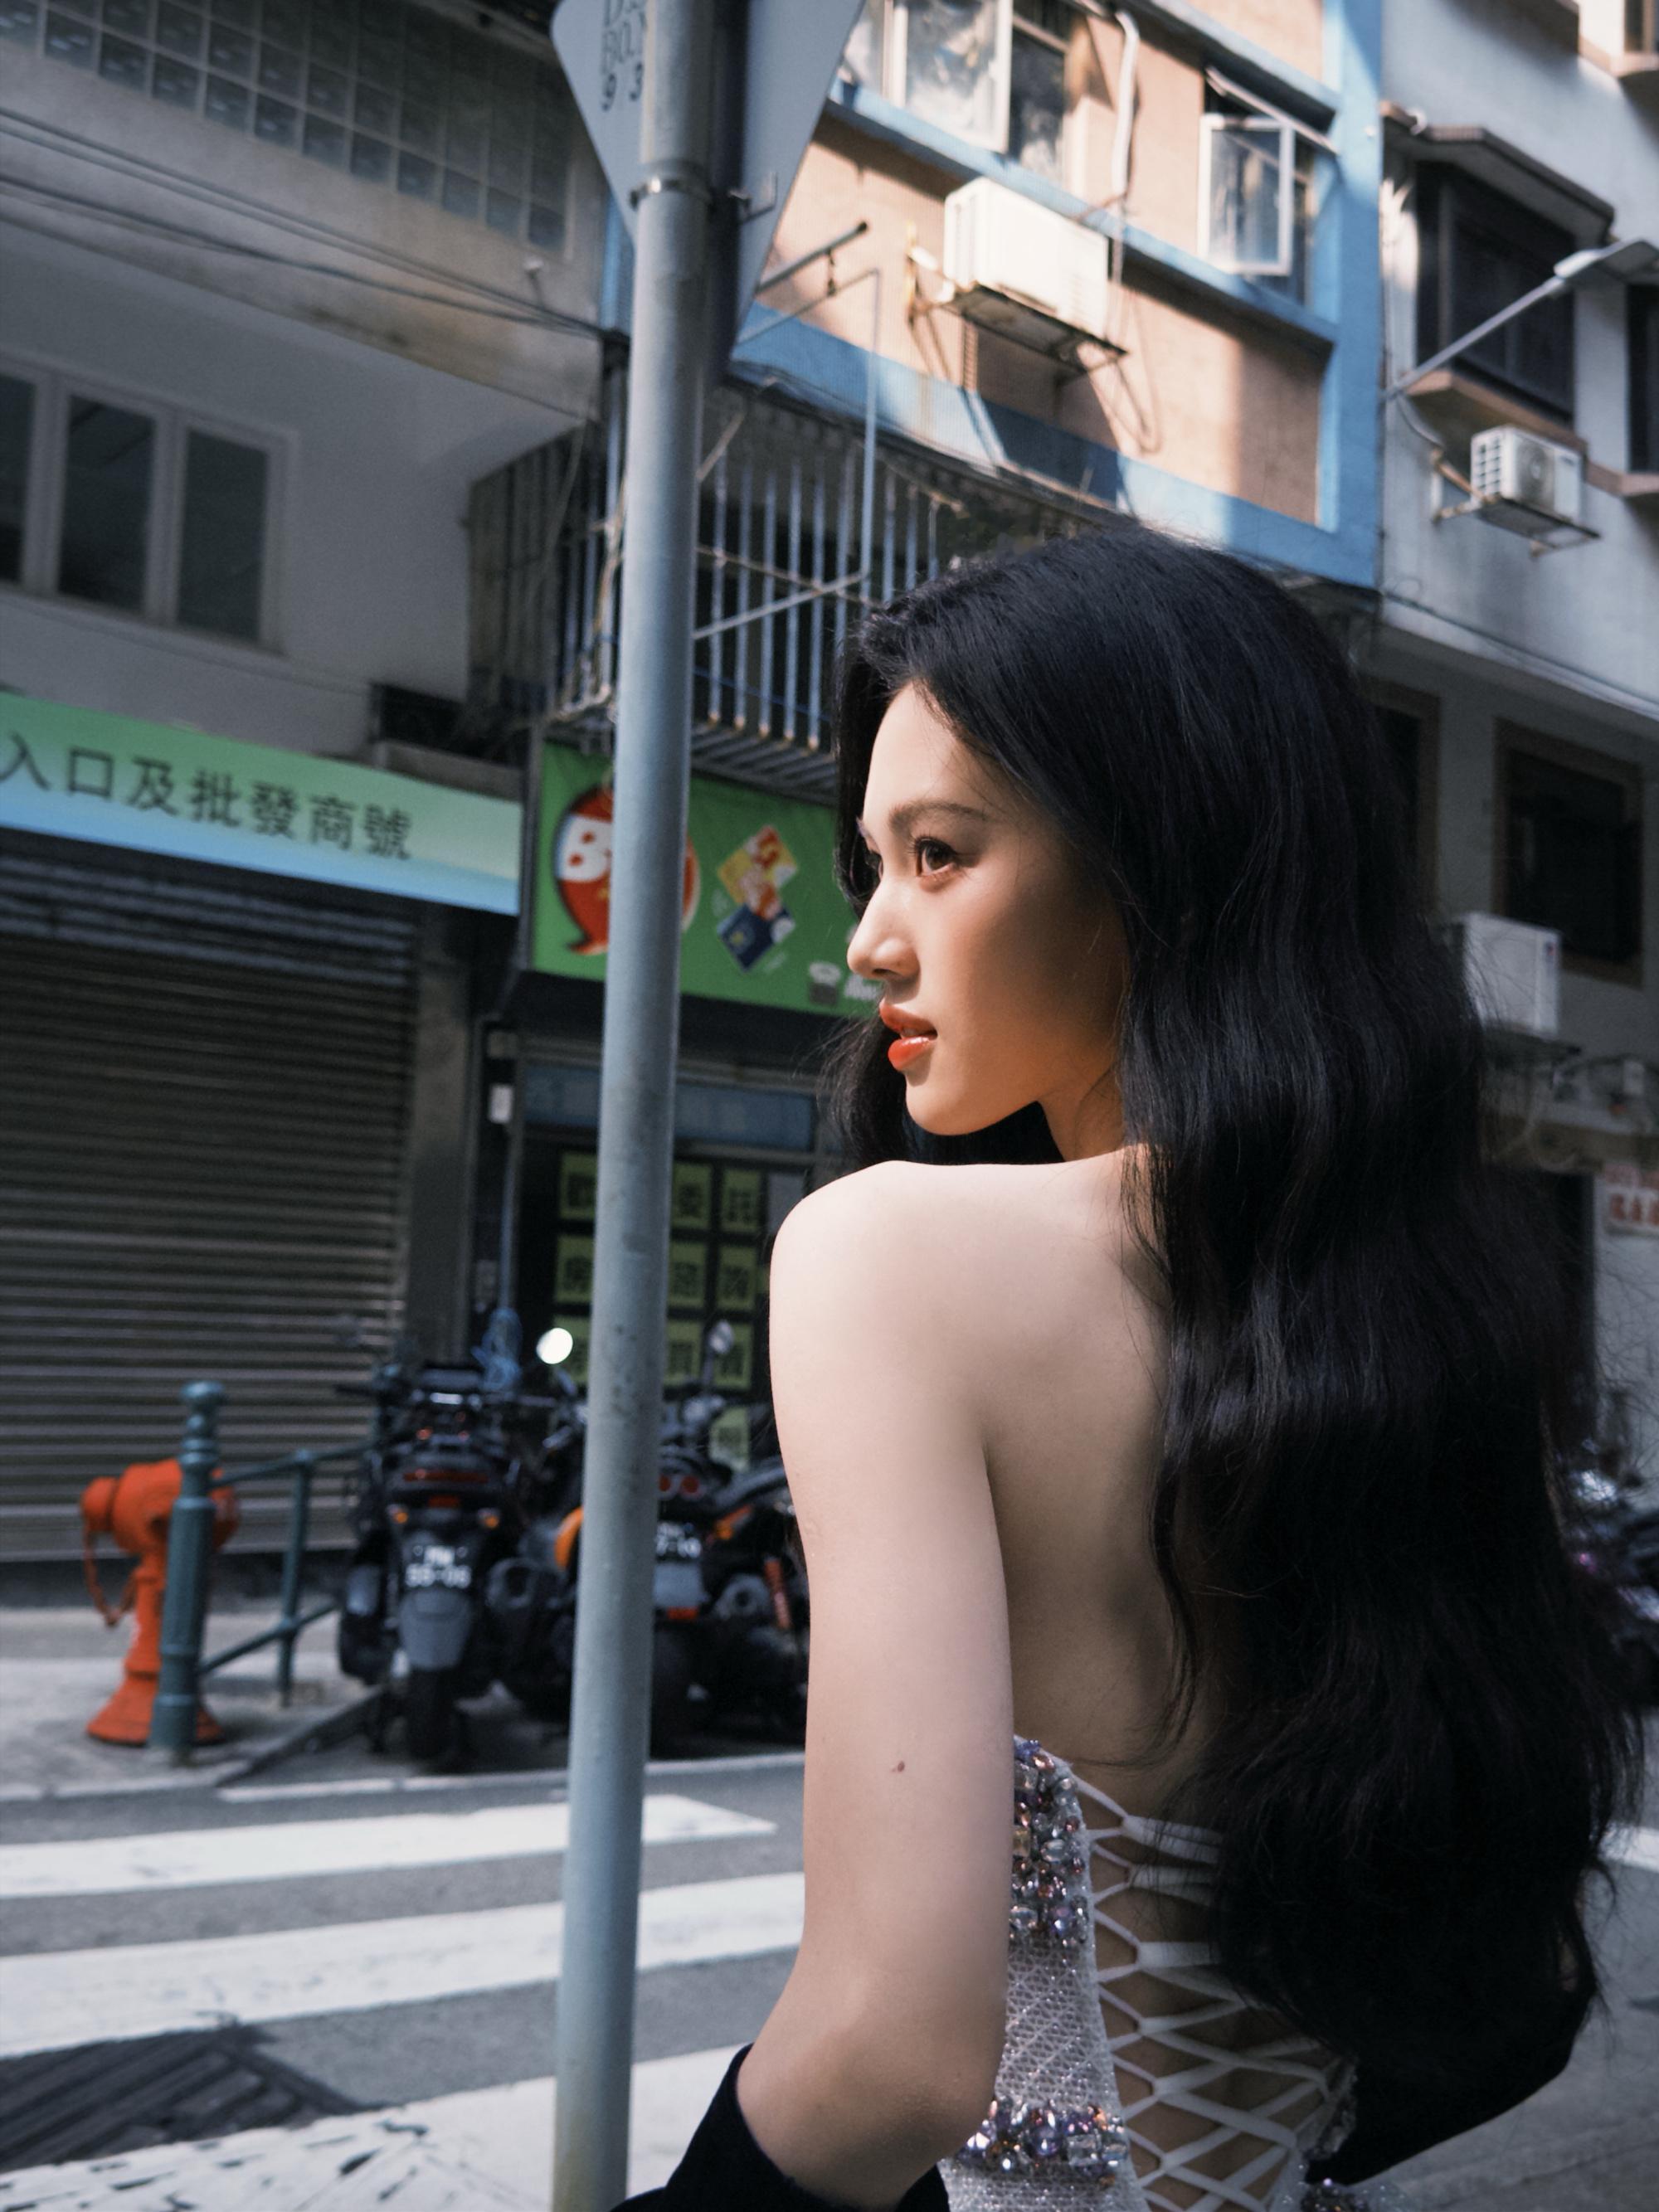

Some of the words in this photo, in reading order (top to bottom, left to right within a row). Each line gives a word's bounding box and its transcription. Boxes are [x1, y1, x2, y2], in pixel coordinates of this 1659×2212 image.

[0, 729, 411, 860] 入口及批發商號
